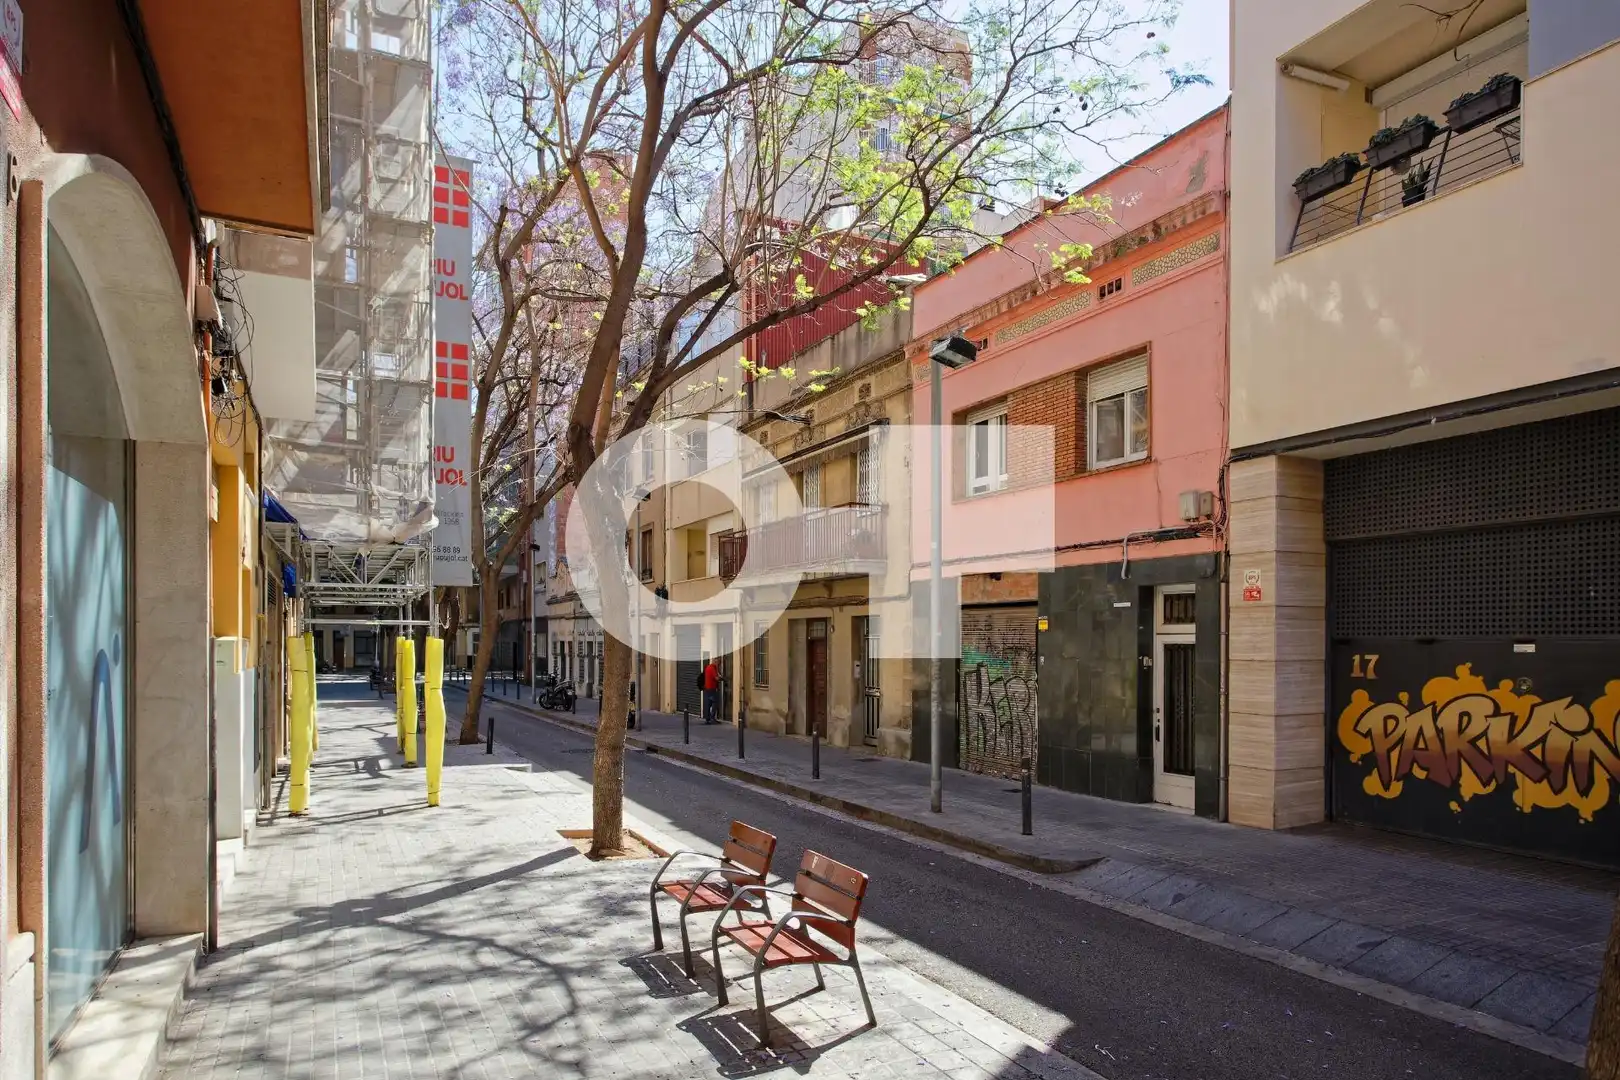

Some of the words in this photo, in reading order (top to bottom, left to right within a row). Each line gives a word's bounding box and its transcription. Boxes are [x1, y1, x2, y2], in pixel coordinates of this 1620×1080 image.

[433, 258, 456, 276] IU
[433, 445, 455, 463] IU
[1351, 654, 1380, 679] 17
